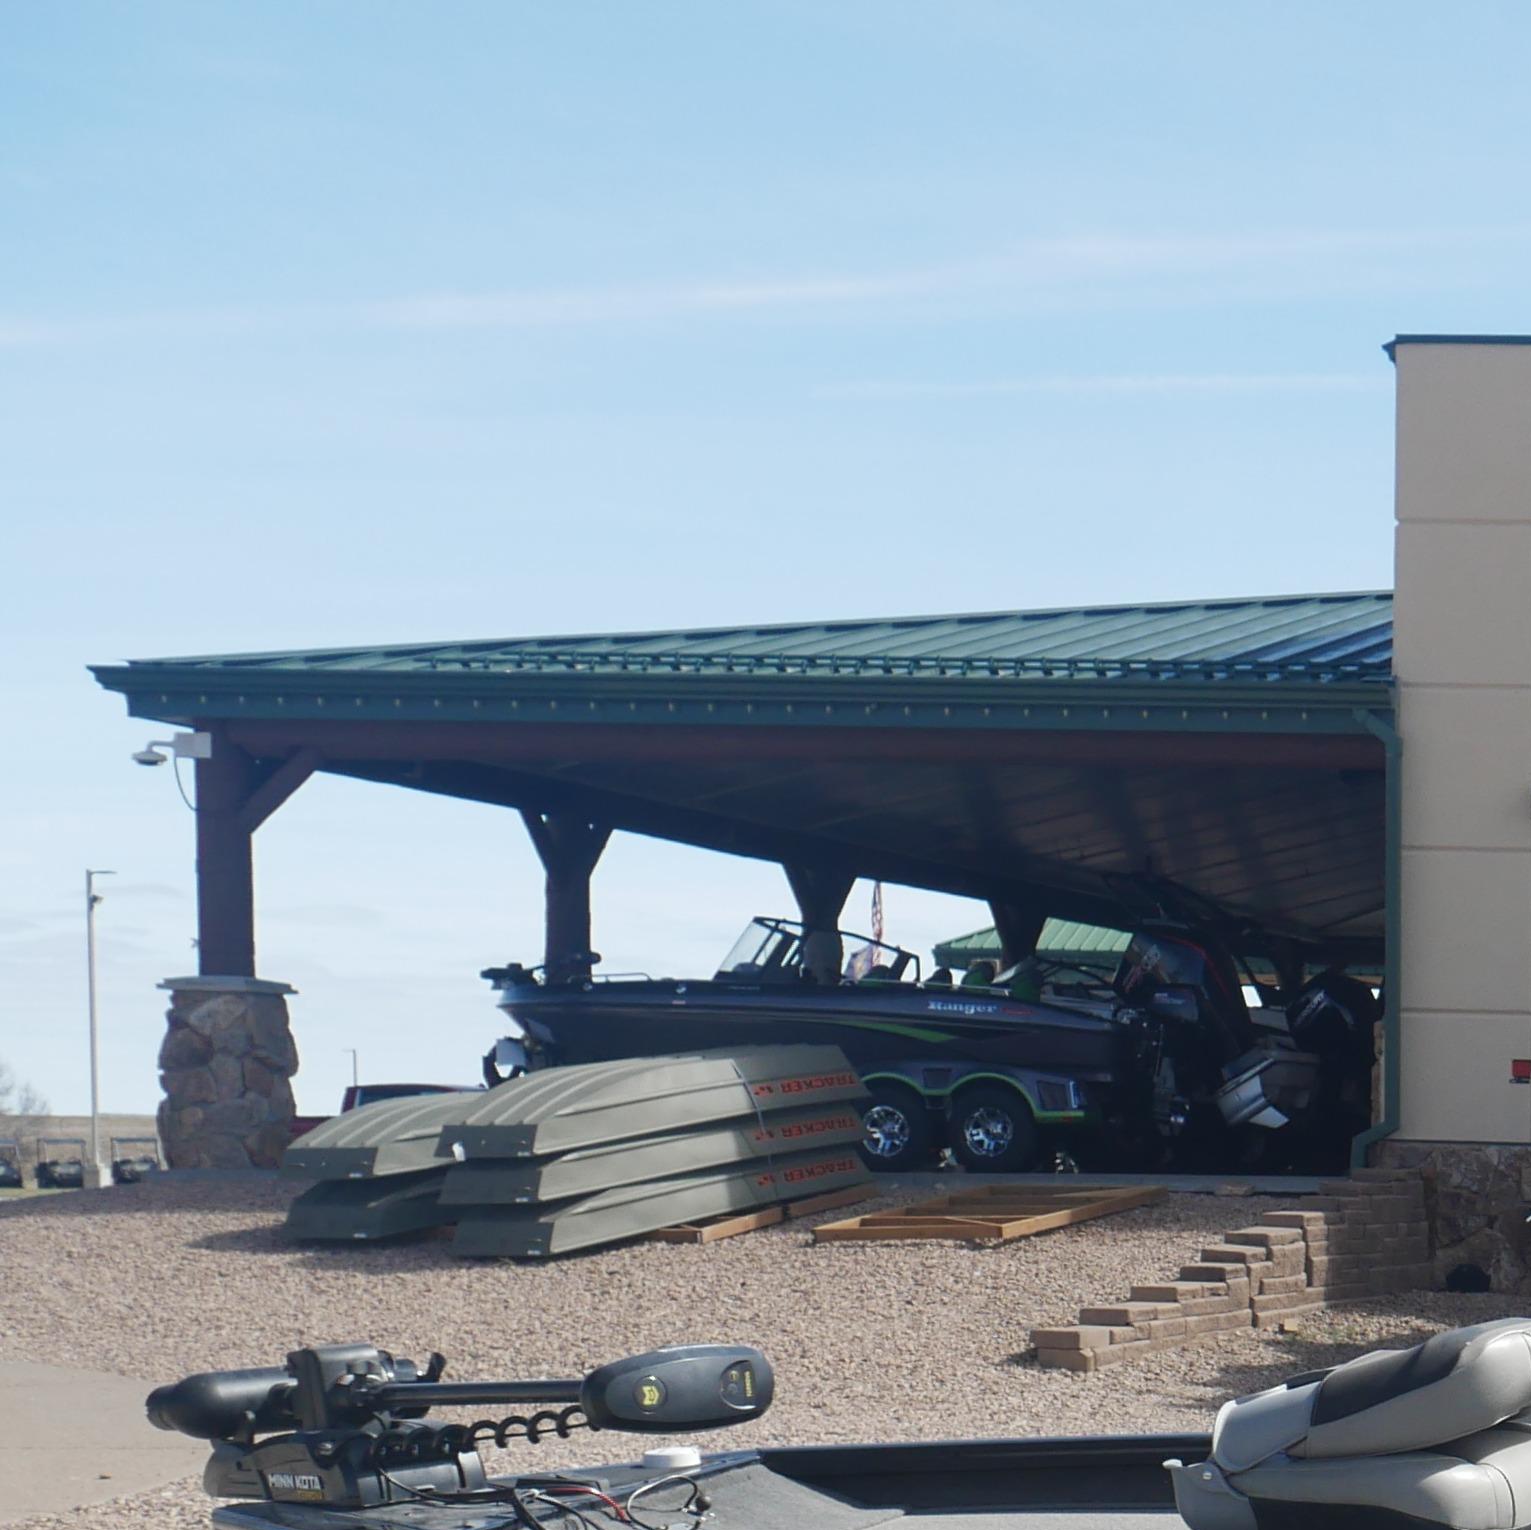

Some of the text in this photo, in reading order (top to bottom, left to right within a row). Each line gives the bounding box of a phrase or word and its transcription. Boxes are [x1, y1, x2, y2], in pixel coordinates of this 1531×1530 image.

[927, 1001, 998, 1015] Ranger
[781, 1074, 856, 1093] TRACKER
[781, 1118, 856, 1138] TRACKER
[295, 1474, 321, 1490] KOTA
